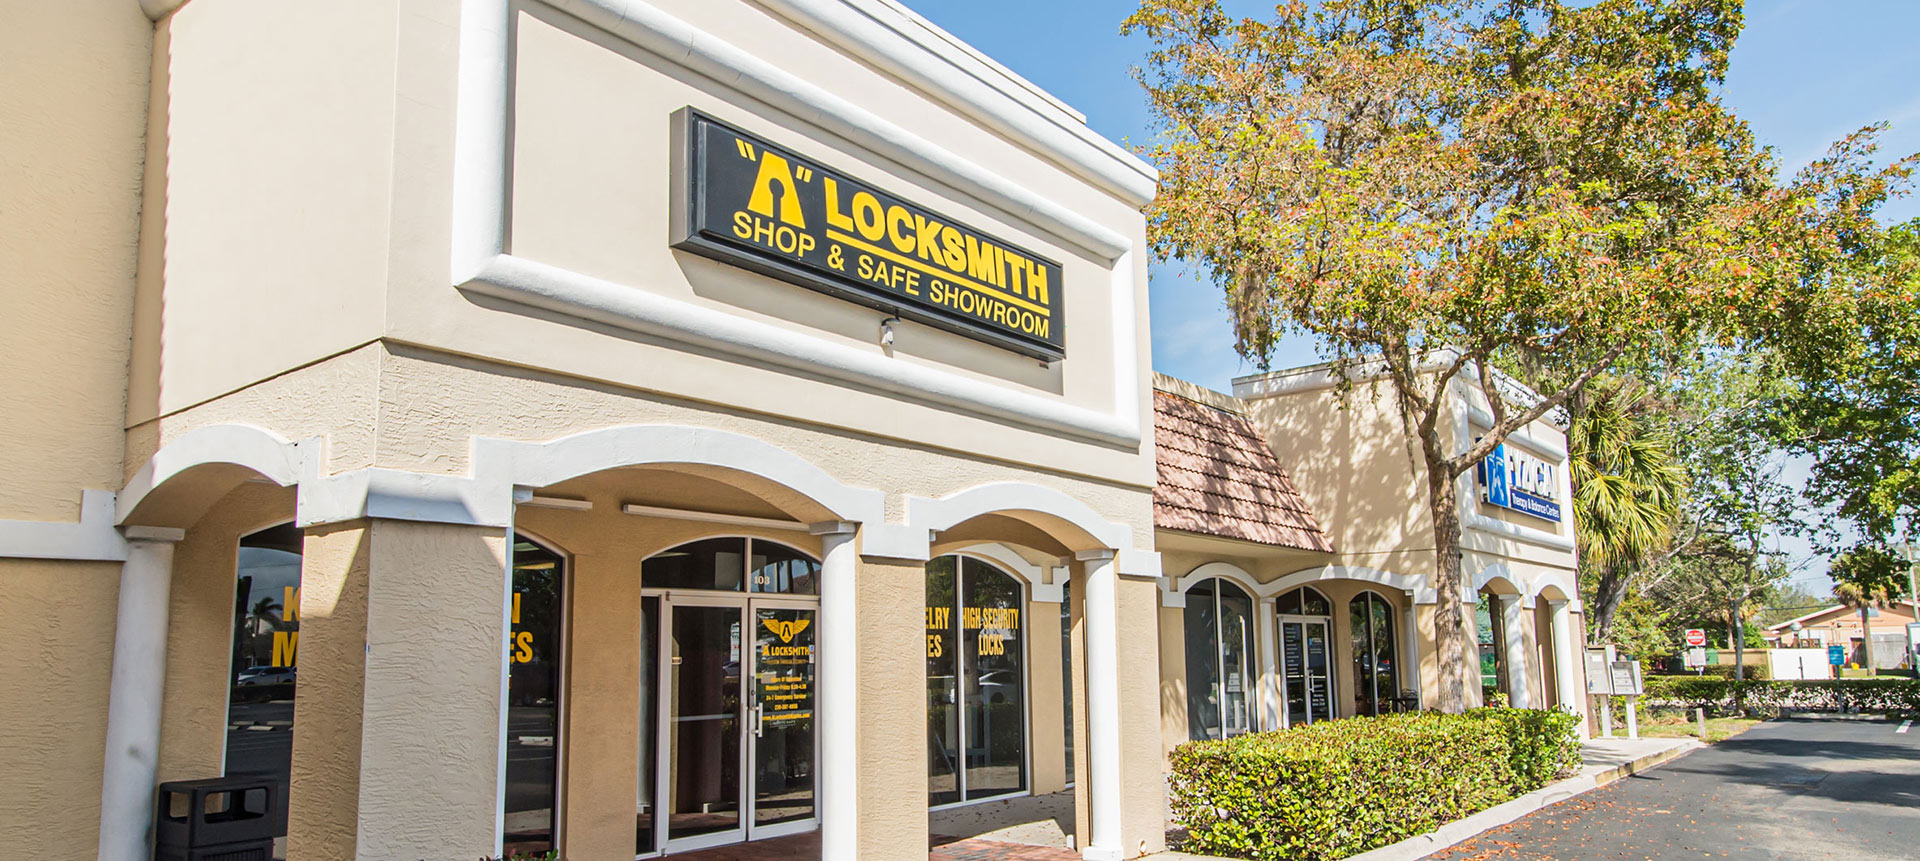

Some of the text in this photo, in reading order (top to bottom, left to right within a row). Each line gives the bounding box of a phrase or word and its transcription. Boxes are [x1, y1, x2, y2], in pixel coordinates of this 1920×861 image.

[823, 176, 1049, 305] LOCKSMITH
[734, 210, 1049, 339] SHOP & SAFE SHOWROOM
[753, 575, 771, 585] 103
[962, 607, 1019, 629] HIGH SECURITY
[771, 646, 809, 656] LOCKSMITH
[978, 633, 1004, 656] LOCKS
